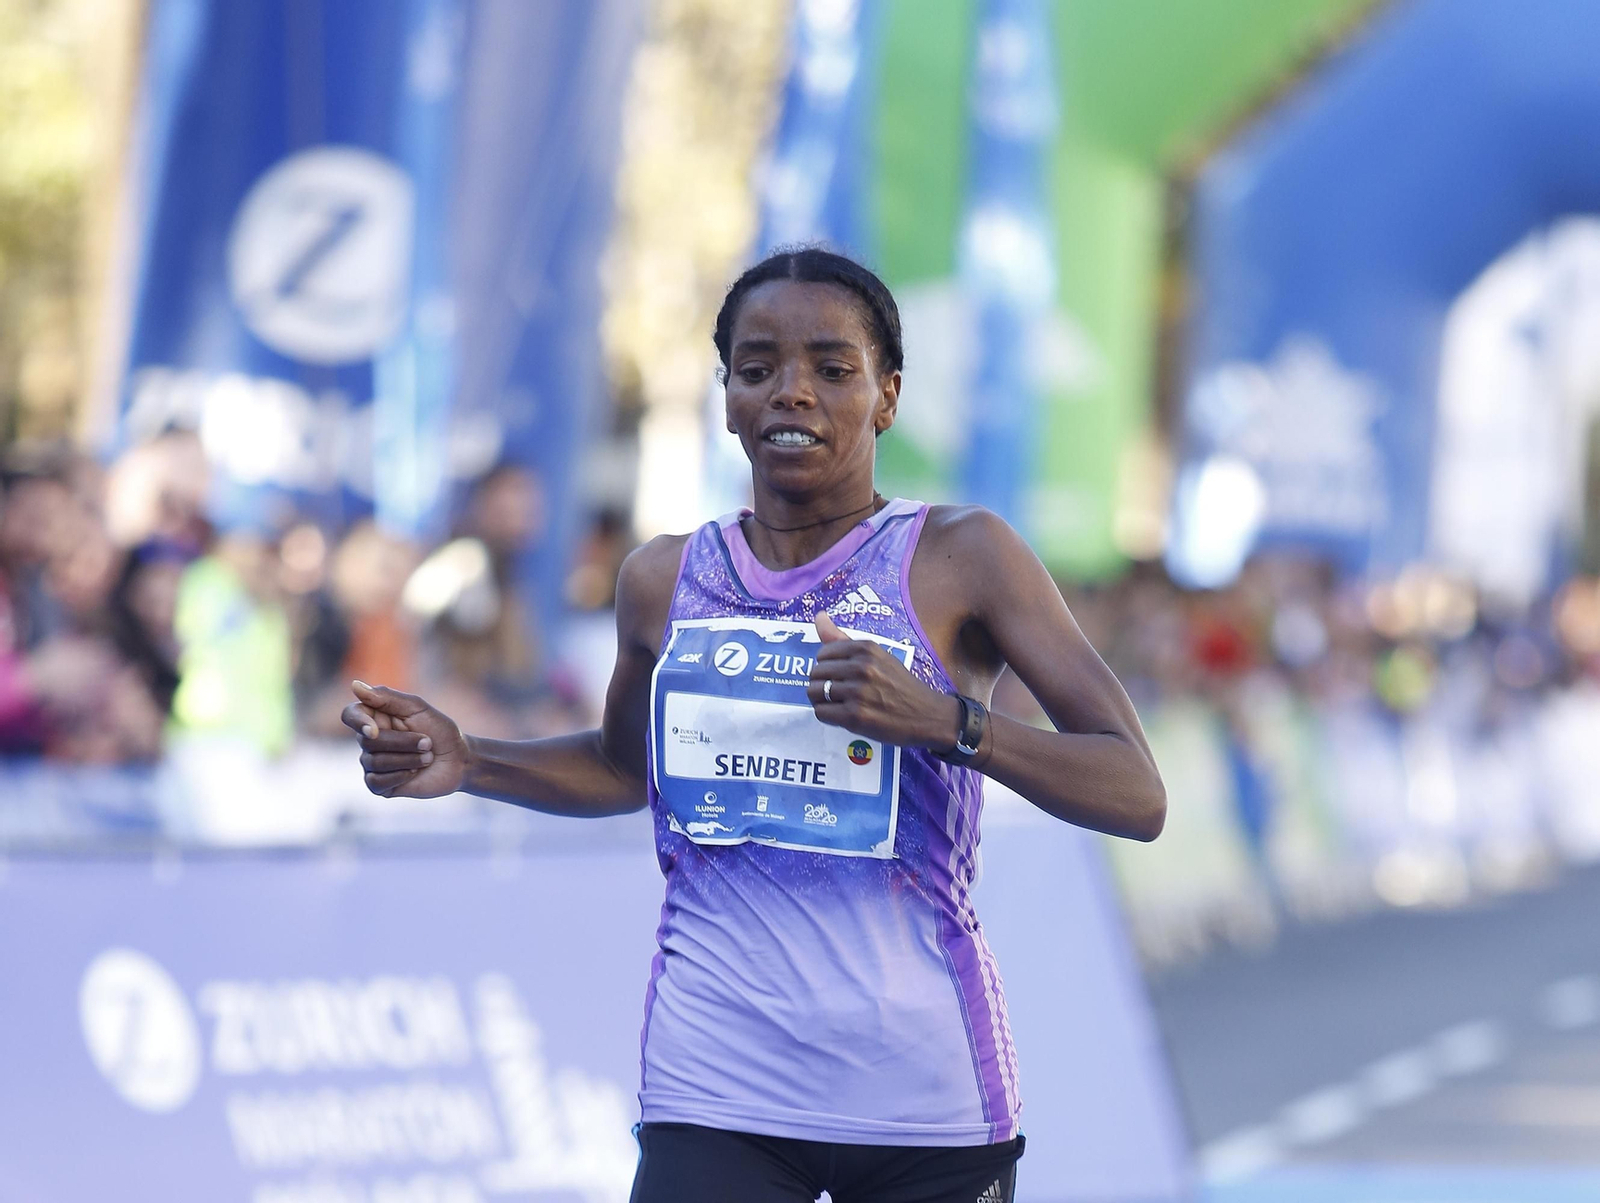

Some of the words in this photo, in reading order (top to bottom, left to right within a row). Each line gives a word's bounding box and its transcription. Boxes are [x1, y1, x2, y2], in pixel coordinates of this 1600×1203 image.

[826, 600, 893, 616] adidas
[677, 653, 703, 664] 42K
[755, 653, 818, 676] ZURI
[753, 675, 775, 684] ZURICH
[715, 754, 827, 785] SENBETE
[695, 805, 726, 813] ILUNION
[804, 803, 838, 824] 2020
